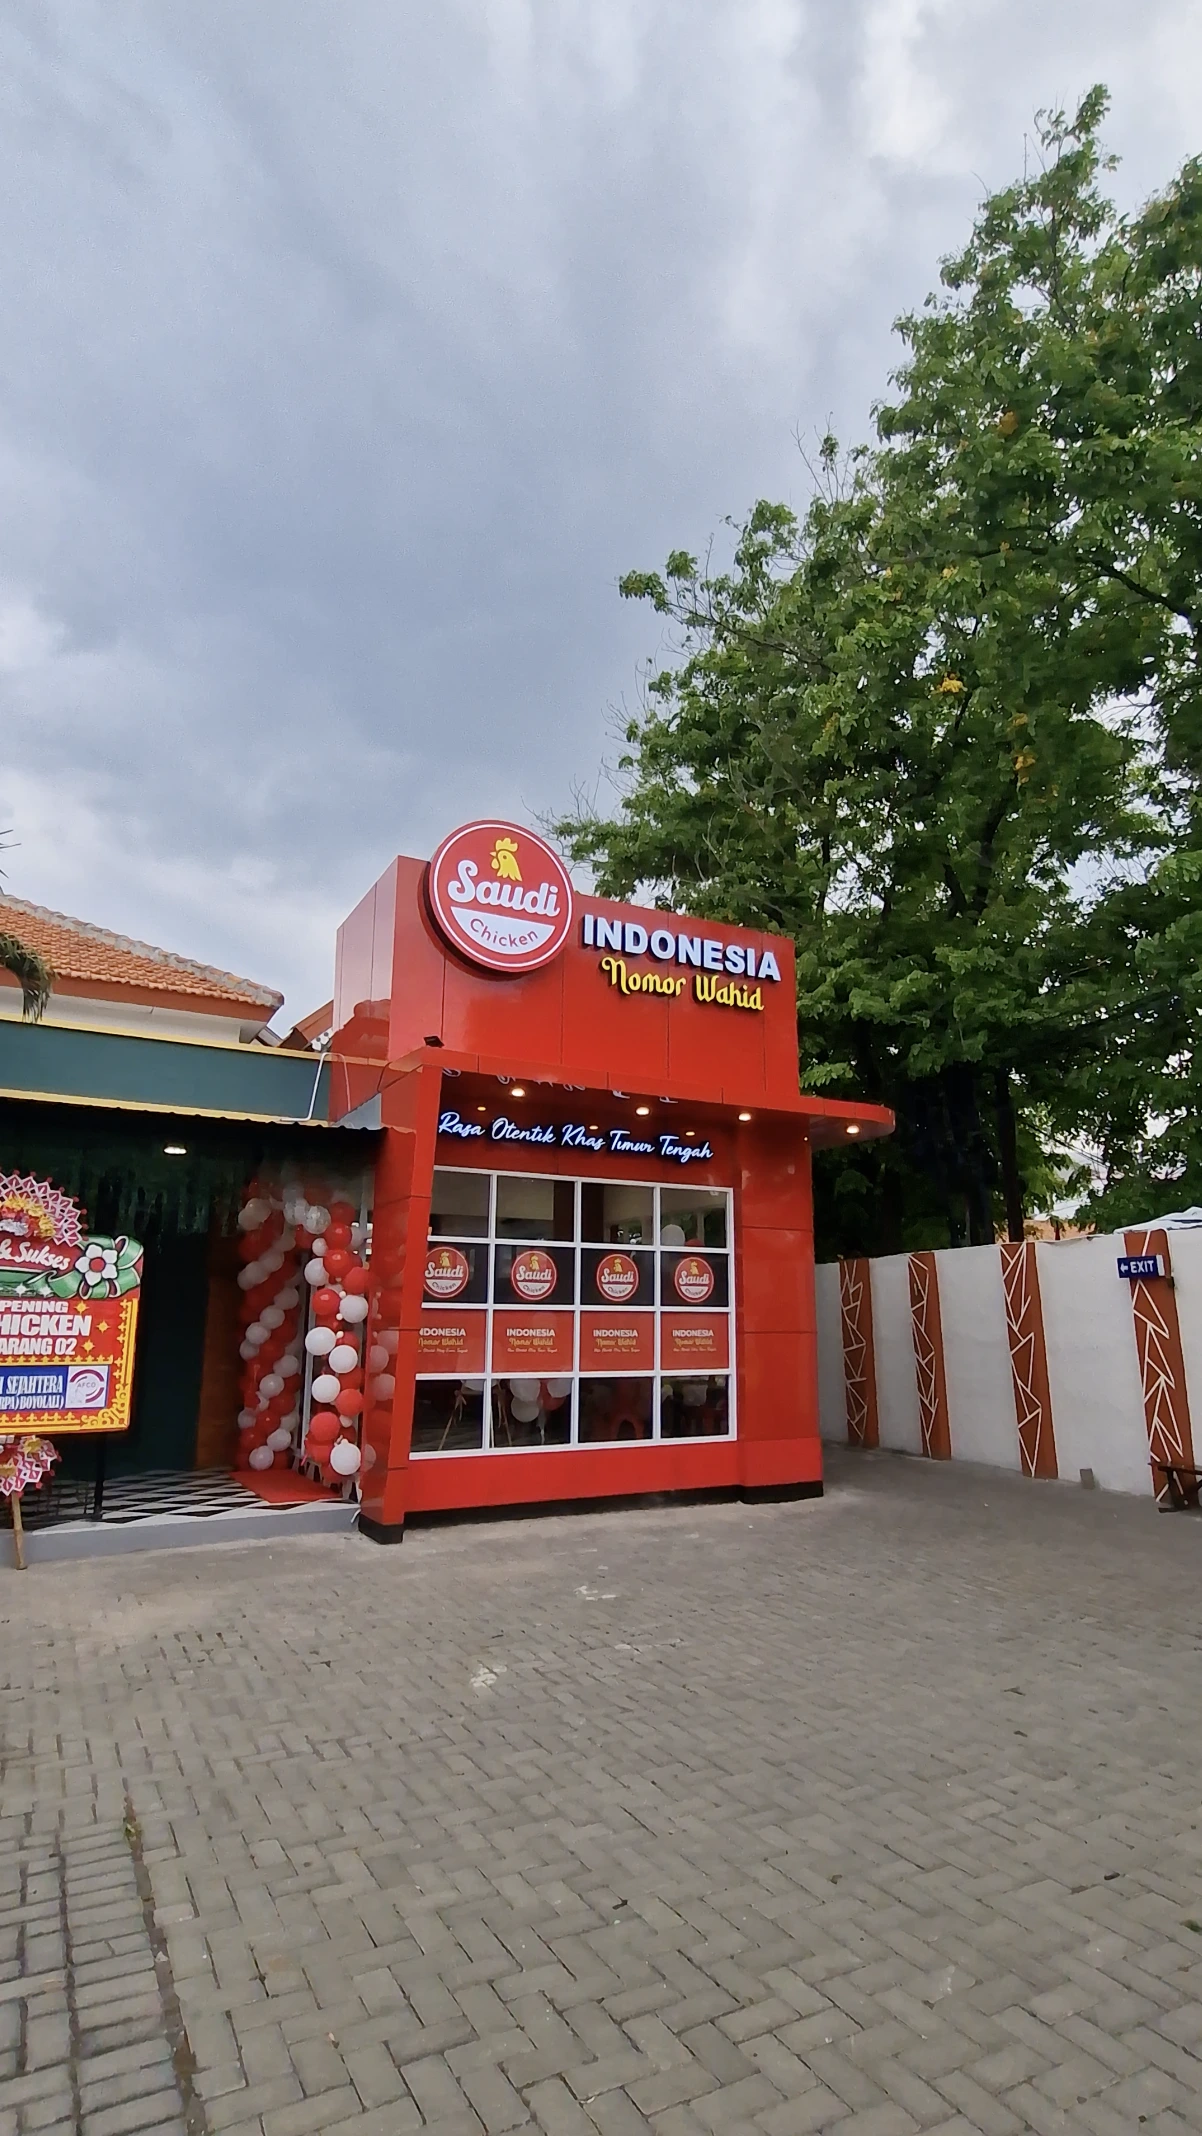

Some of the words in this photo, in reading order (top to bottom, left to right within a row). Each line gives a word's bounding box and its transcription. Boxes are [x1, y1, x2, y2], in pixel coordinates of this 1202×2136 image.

[448, 859, 560, 917] Saudi
[469, 917, 538, 947] Chicken
[583, 914, 782, 982] INDONESIA
[601, 956, 686, 996] Nomor
[695, 974, 765, 1011] Wahid
[438, 1111, 485, 1137] Rasa
[491, 1117, 556, 1144] Otentik
[561, 1124, 606, 1151] Khas
[610, 1129, 655, 1153] Timur
[659, 1135, 714, 1163] Tengah
[14, 1242, 71, 1270] Sukses
[425, 1262, 464, 1278] Saudi
[516, 1266, 552, 1281] Saudi
[1130, 1260, 1154, 1273] EXIT
[601, 1268, 635, 1283] Saudi
[679, 1270, 710, 1285] Saudi
[432, 1281, 457, 1291] Chicken
[507, 1328, 555, 1337] INDONESIA
[593, 1329, 638, 1337] INDONESIA
[672, 1329, 714, 1337] INDONESIA
[54, 1338, 78, 1355] 02
[5, 1375, 63, 1395] SEJAHTERA
[77, 1381, 97, 1389] AFCO
